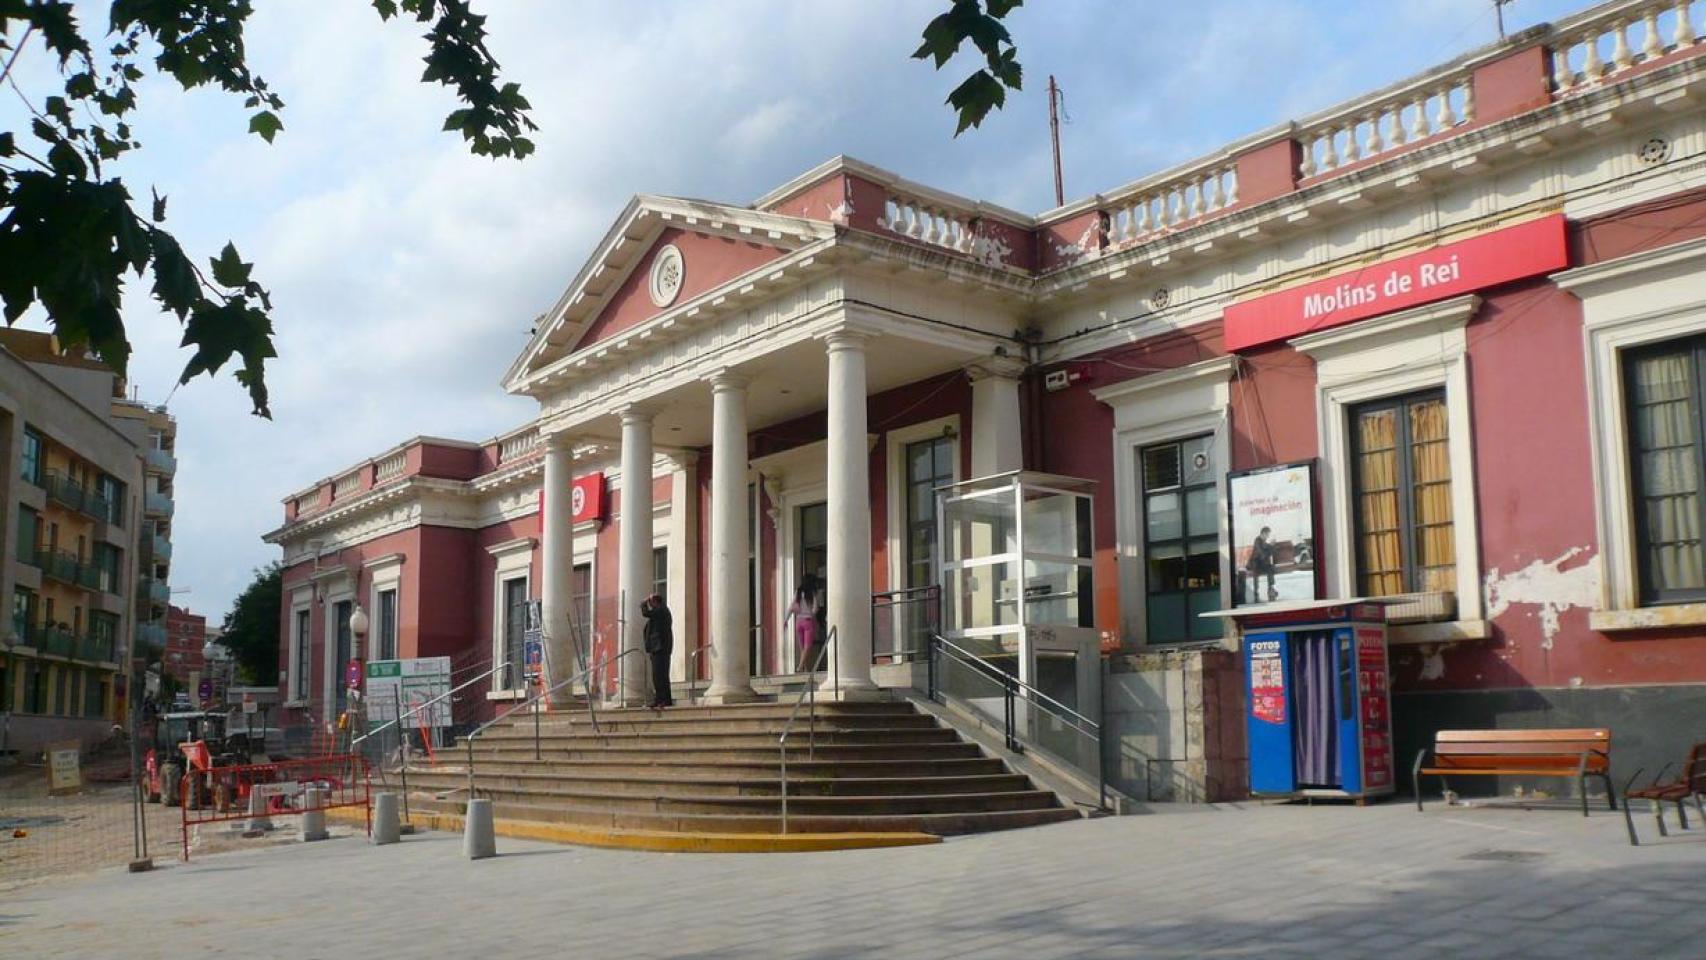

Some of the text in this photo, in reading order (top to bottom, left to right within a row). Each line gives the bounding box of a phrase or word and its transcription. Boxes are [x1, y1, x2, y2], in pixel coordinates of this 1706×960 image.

[1304, 255, 1460, 318] Molins de Rei
[1250, 500, 1303, 515] imaginación
[1251, 641, 1280, 650] FOTOS
